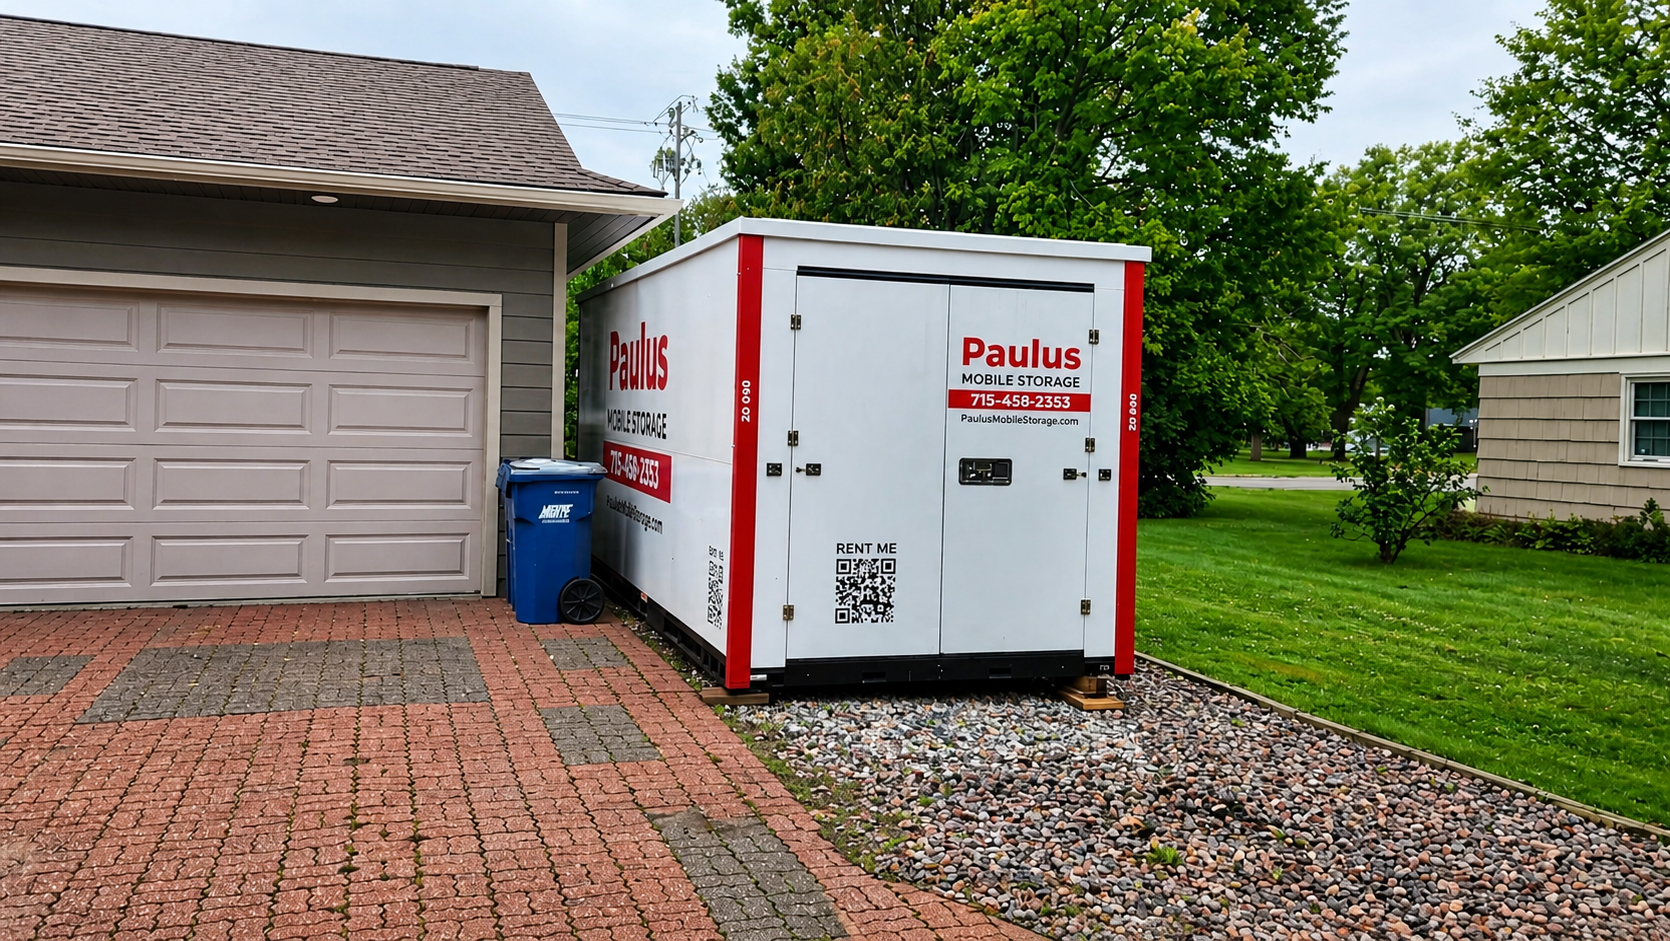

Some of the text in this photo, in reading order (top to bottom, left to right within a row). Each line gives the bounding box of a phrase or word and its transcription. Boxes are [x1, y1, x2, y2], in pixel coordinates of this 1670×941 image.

[608, 321, 668, 391] Paulus
[962, 337, 1081, 370] Paulus
[962, 373, 1080, 388] MOBILE STORAGE
[970, 393, 1071, 409] 715-458-2353
[741, 406, 751, 422] 20
[961, 414, 1079, 427] PaulusMobileStorage.com
[607, 408, 667, 440] MOBILE STORAGE
[1128, 417, 1137, 431] 20
[836, 543, 897, 554] RENT ME
